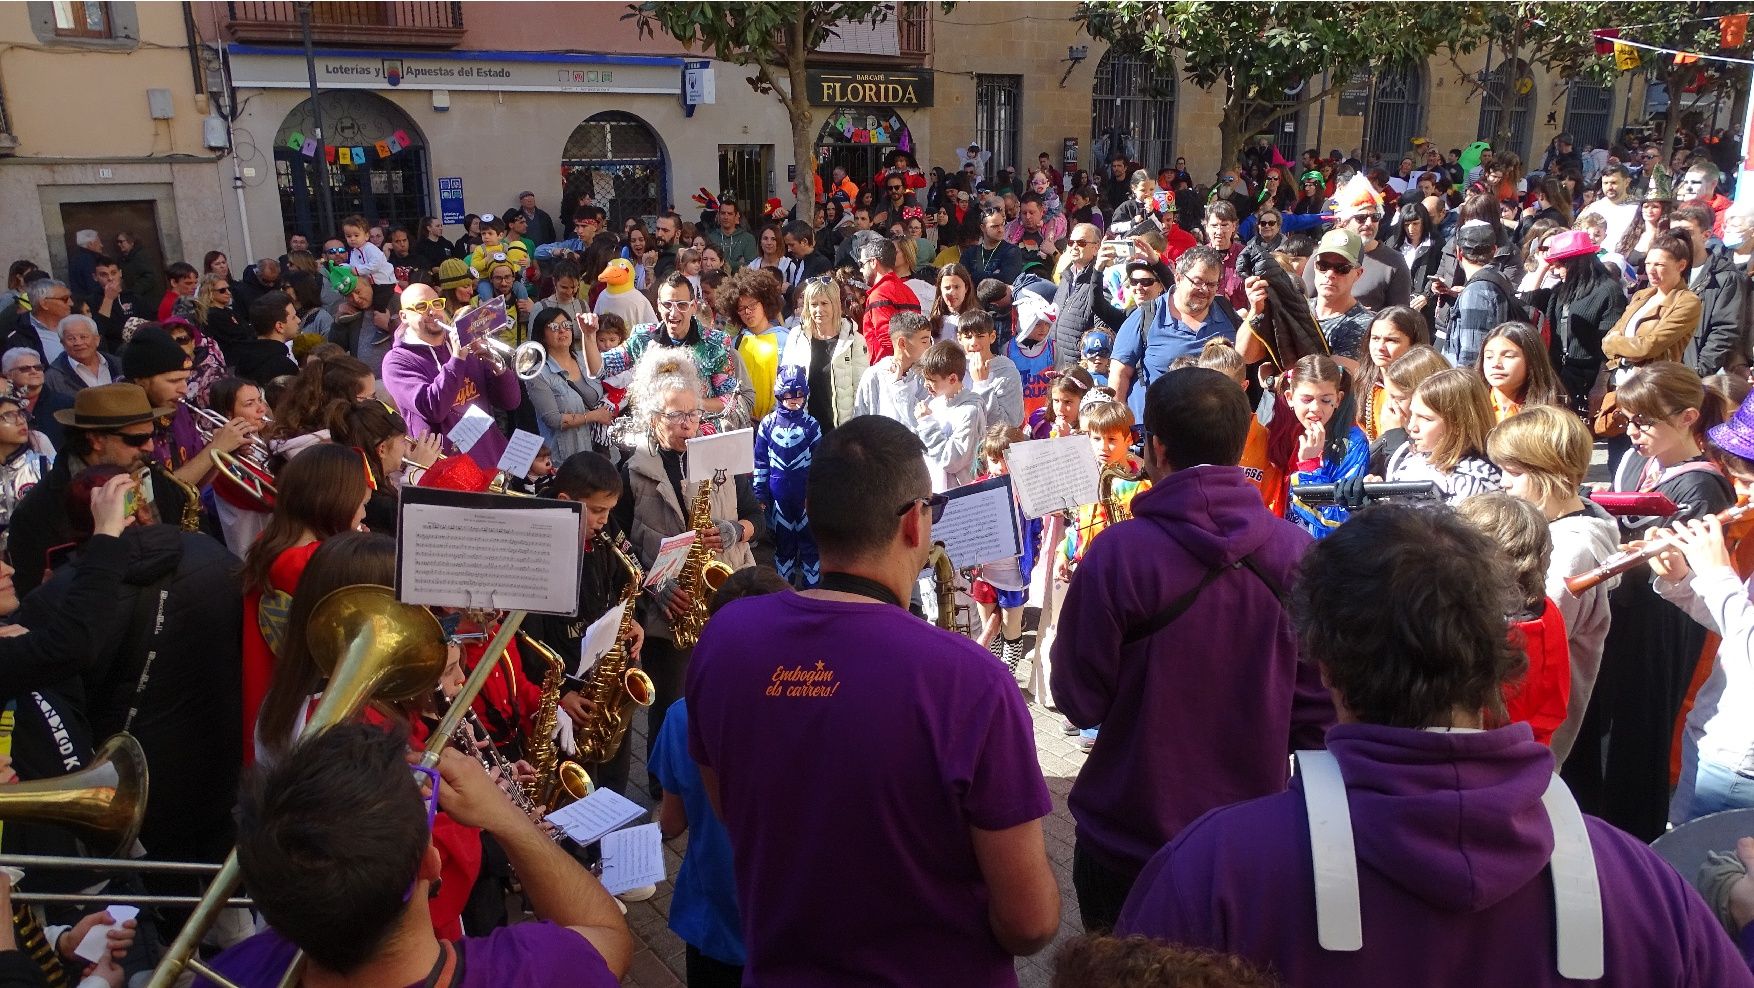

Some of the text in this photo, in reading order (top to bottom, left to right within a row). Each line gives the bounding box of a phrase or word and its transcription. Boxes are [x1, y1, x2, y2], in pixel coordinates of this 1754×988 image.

[374, 67, 381, 78] y
[405, 67, 455, 78] Apuestas
[458, 67, 474, 77] del
[477, 68, 511, 78] Estado
[821, 82, 918, 103] FLORIDA
[771, 664, 834, 686] Embogim
[765, 680, 841, 697] els carrers!
